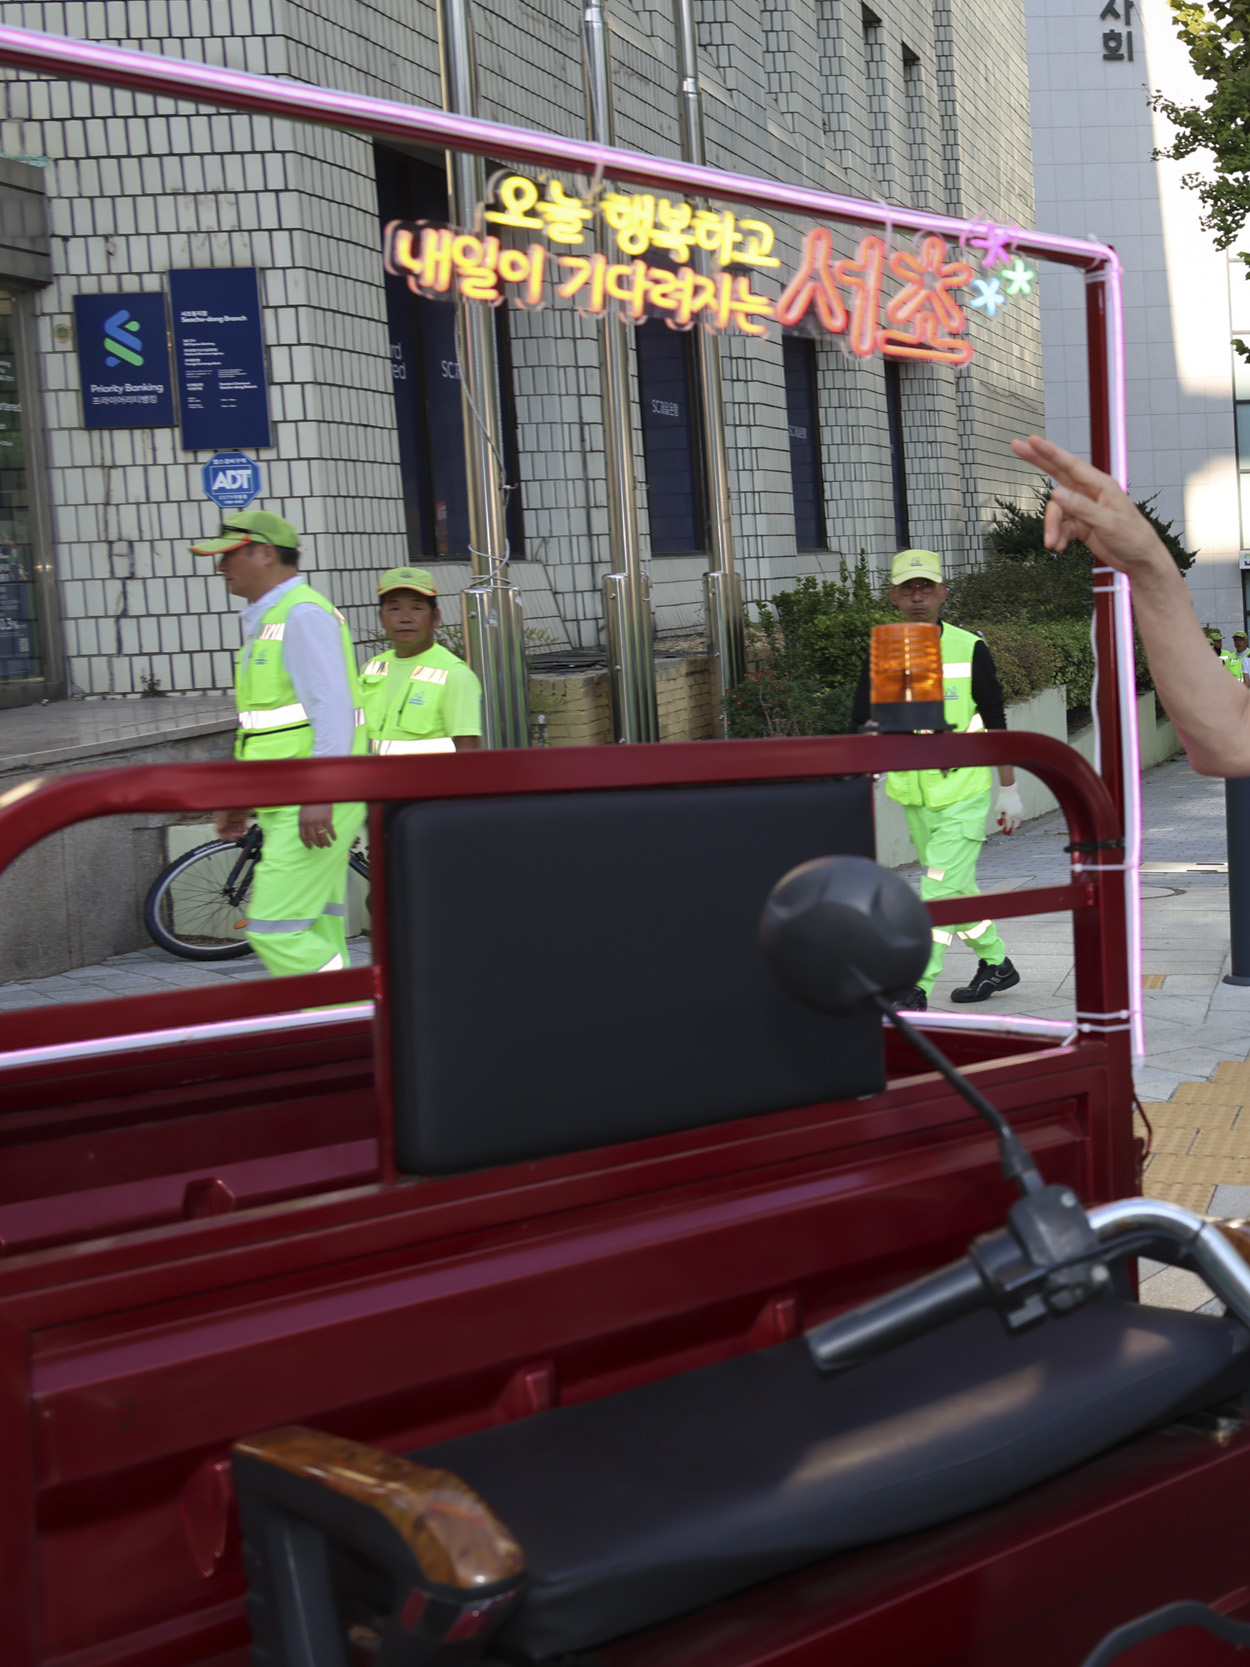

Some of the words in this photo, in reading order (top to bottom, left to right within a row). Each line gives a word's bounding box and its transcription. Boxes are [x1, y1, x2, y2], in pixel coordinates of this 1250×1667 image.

[485, 176, 593, 244] 오늘
[602, 193, 781, 268] 행복하고
[398, 227, 546, 305] 내일이
[558, 253, 776, 336] 기다려지는
[776, 226, 974, 364] 서초
[90, 384, 124, 394] Priority
[124, 383, 164, 393] Banking
[212, 469, 252, 490] ADT
